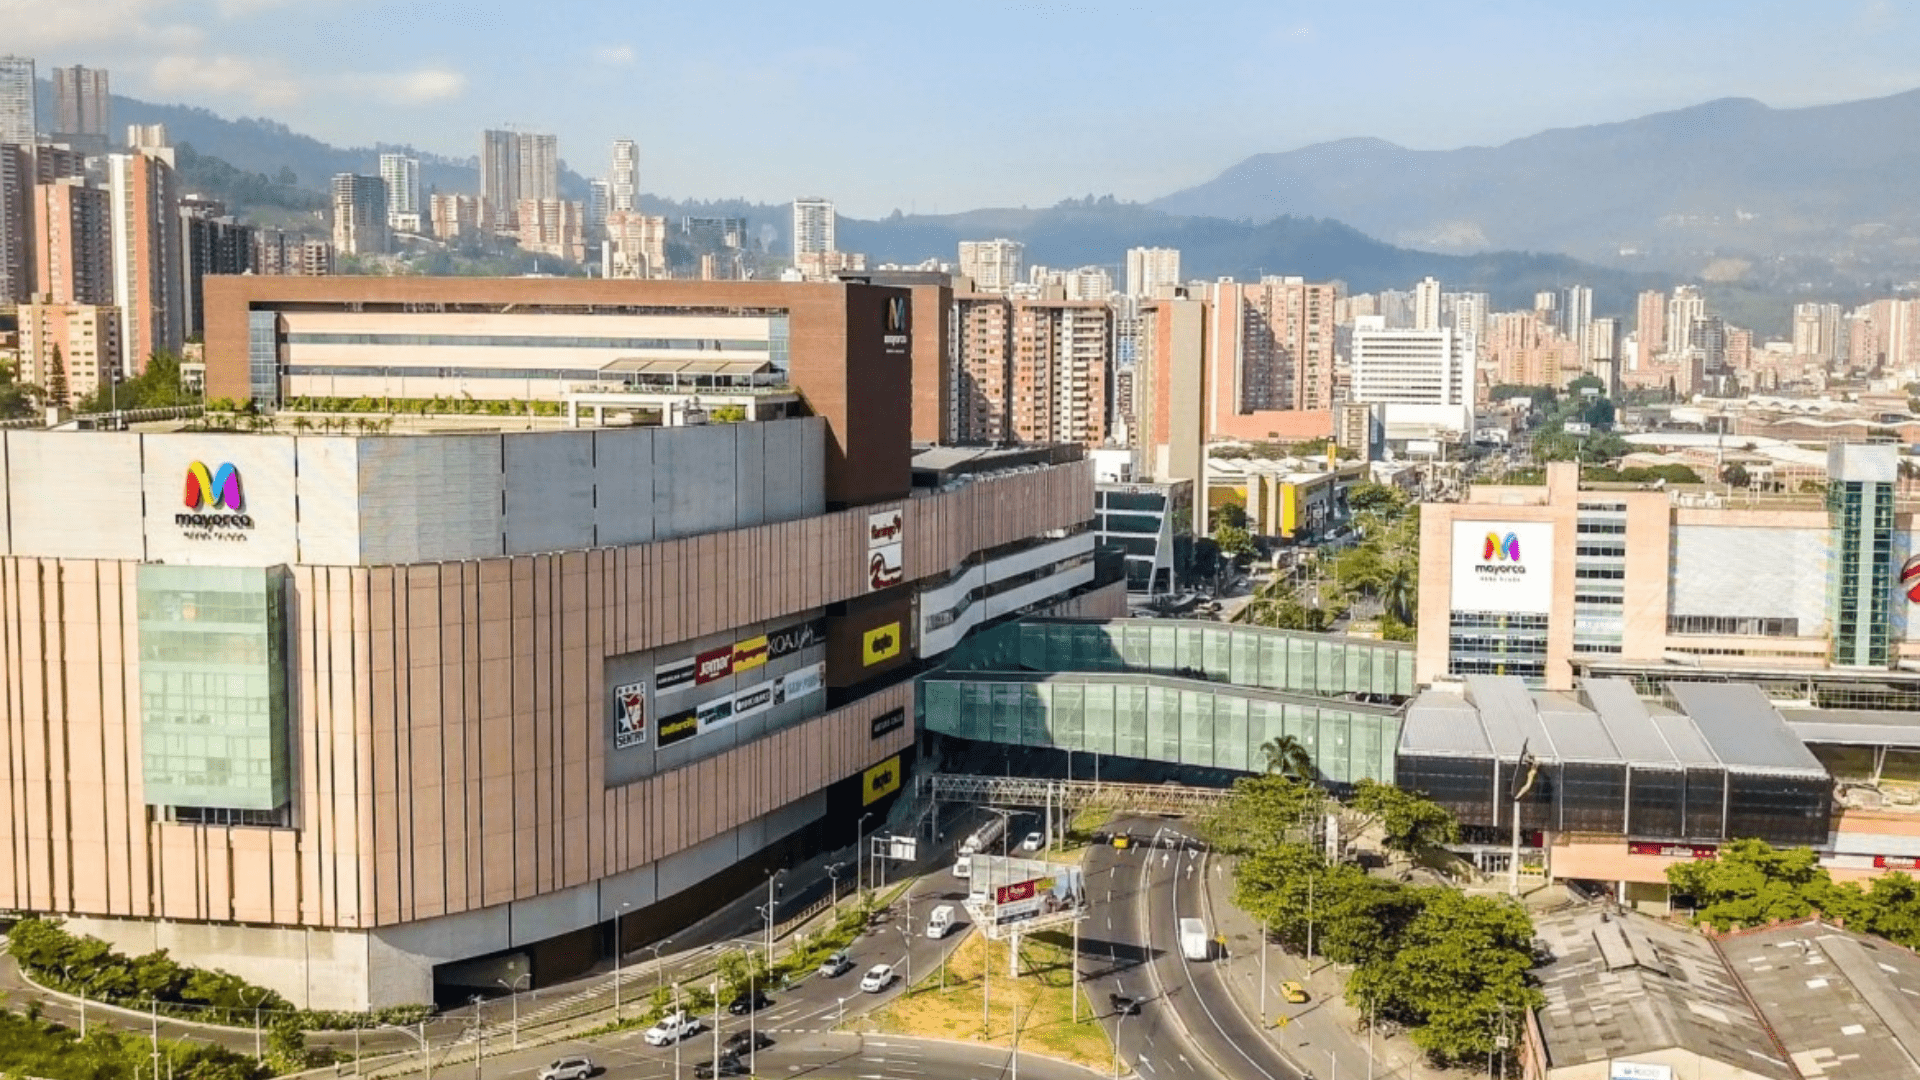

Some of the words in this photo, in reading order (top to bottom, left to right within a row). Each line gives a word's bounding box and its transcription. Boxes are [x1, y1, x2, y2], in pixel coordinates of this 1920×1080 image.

[175, 513, 254, 532] mayorca
[1475, 565, 1526, 575] mayorca
[767, 630, 799, 655] KOAJ
